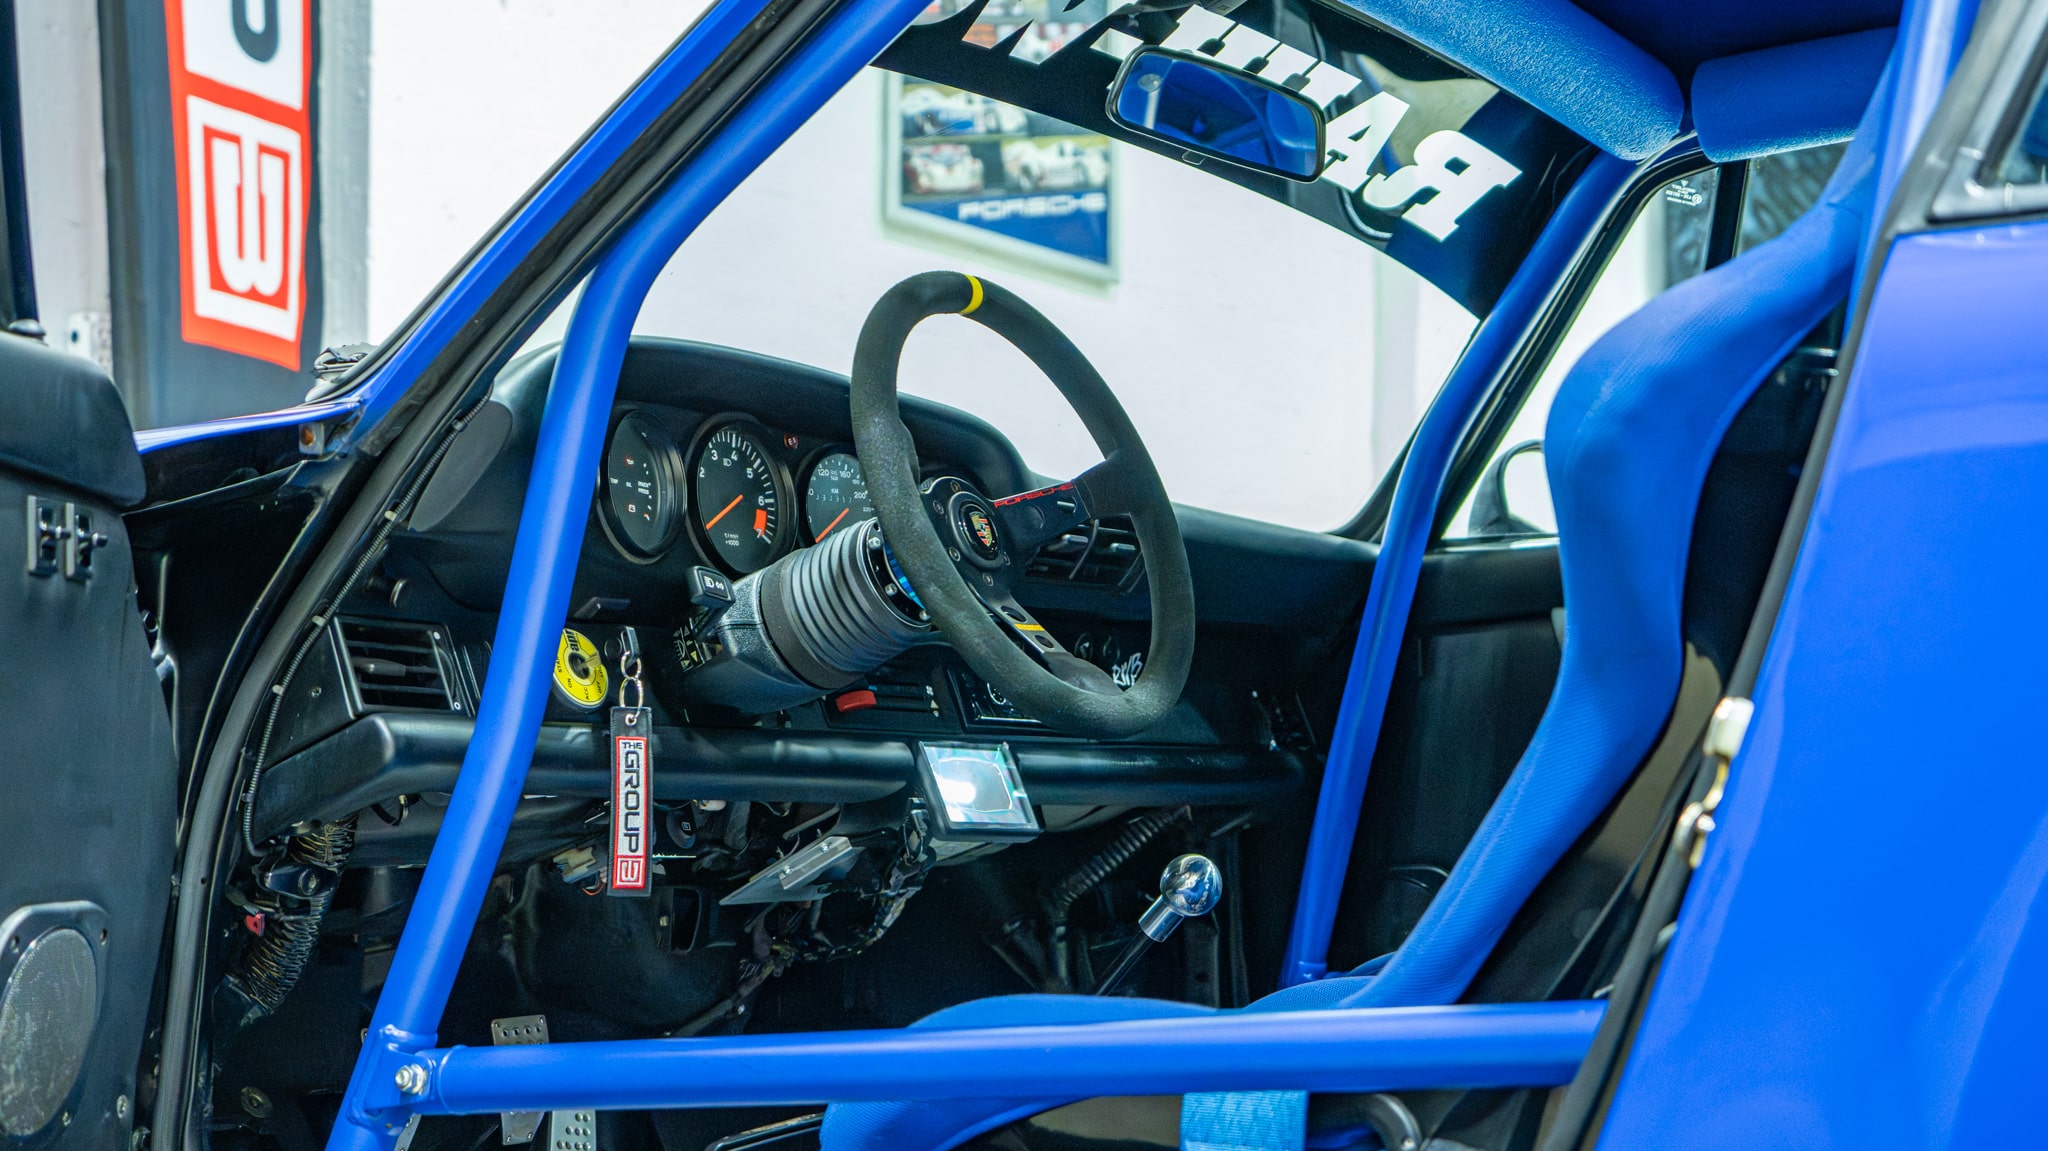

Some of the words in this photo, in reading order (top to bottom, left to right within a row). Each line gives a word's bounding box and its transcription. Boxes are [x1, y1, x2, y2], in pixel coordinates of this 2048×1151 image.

[958, 192, 1107, 221] PORSCHE
[711, 450, 718, 460] 3
[731, 451, 738, 461] 4
[699, 467, 705, 478] 2
[746, 468, 753, 479] 5
[840, 470, 851, 478] 160
[854, 491, 866, 499] 200
[993, 482, 1074, 508] PORSCHE
[758, 496, 765, 506] 6
[621, 741, 643, 749] THE
[623, 750, 640, 853] GROUP
